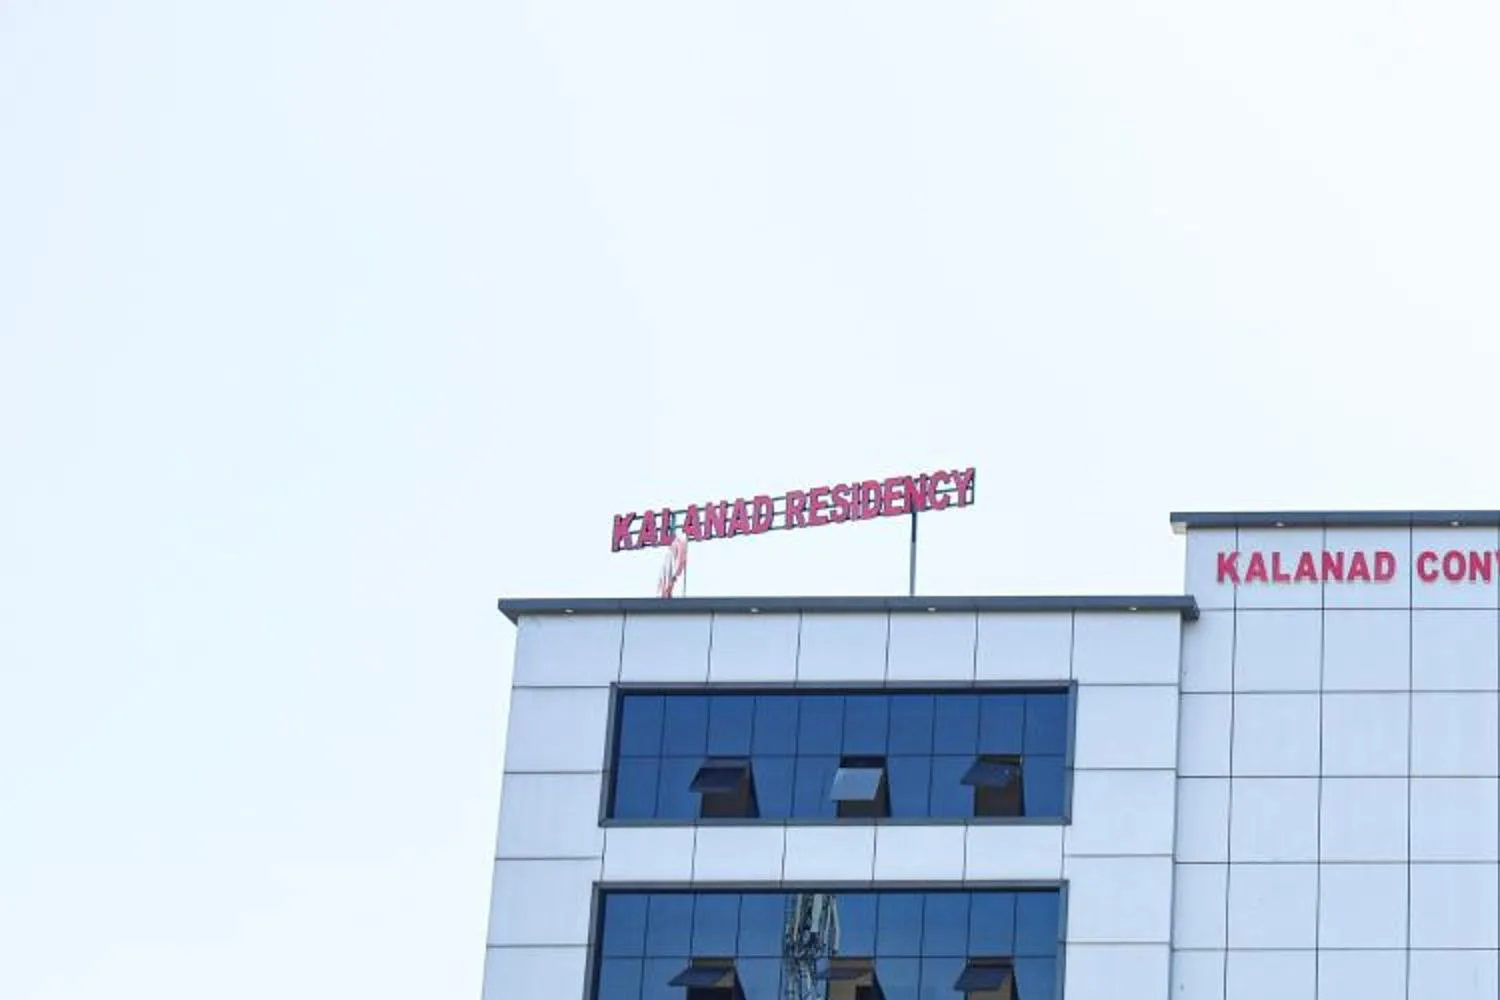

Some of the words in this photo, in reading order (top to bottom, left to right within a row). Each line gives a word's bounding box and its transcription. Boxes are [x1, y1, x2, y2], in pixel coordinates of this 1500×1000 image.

[611, 495, 774, 552] KALANAD
[785, 467, 976, 530] RESIDENCY
[1216, 550, 1396, 583] KALANAD
